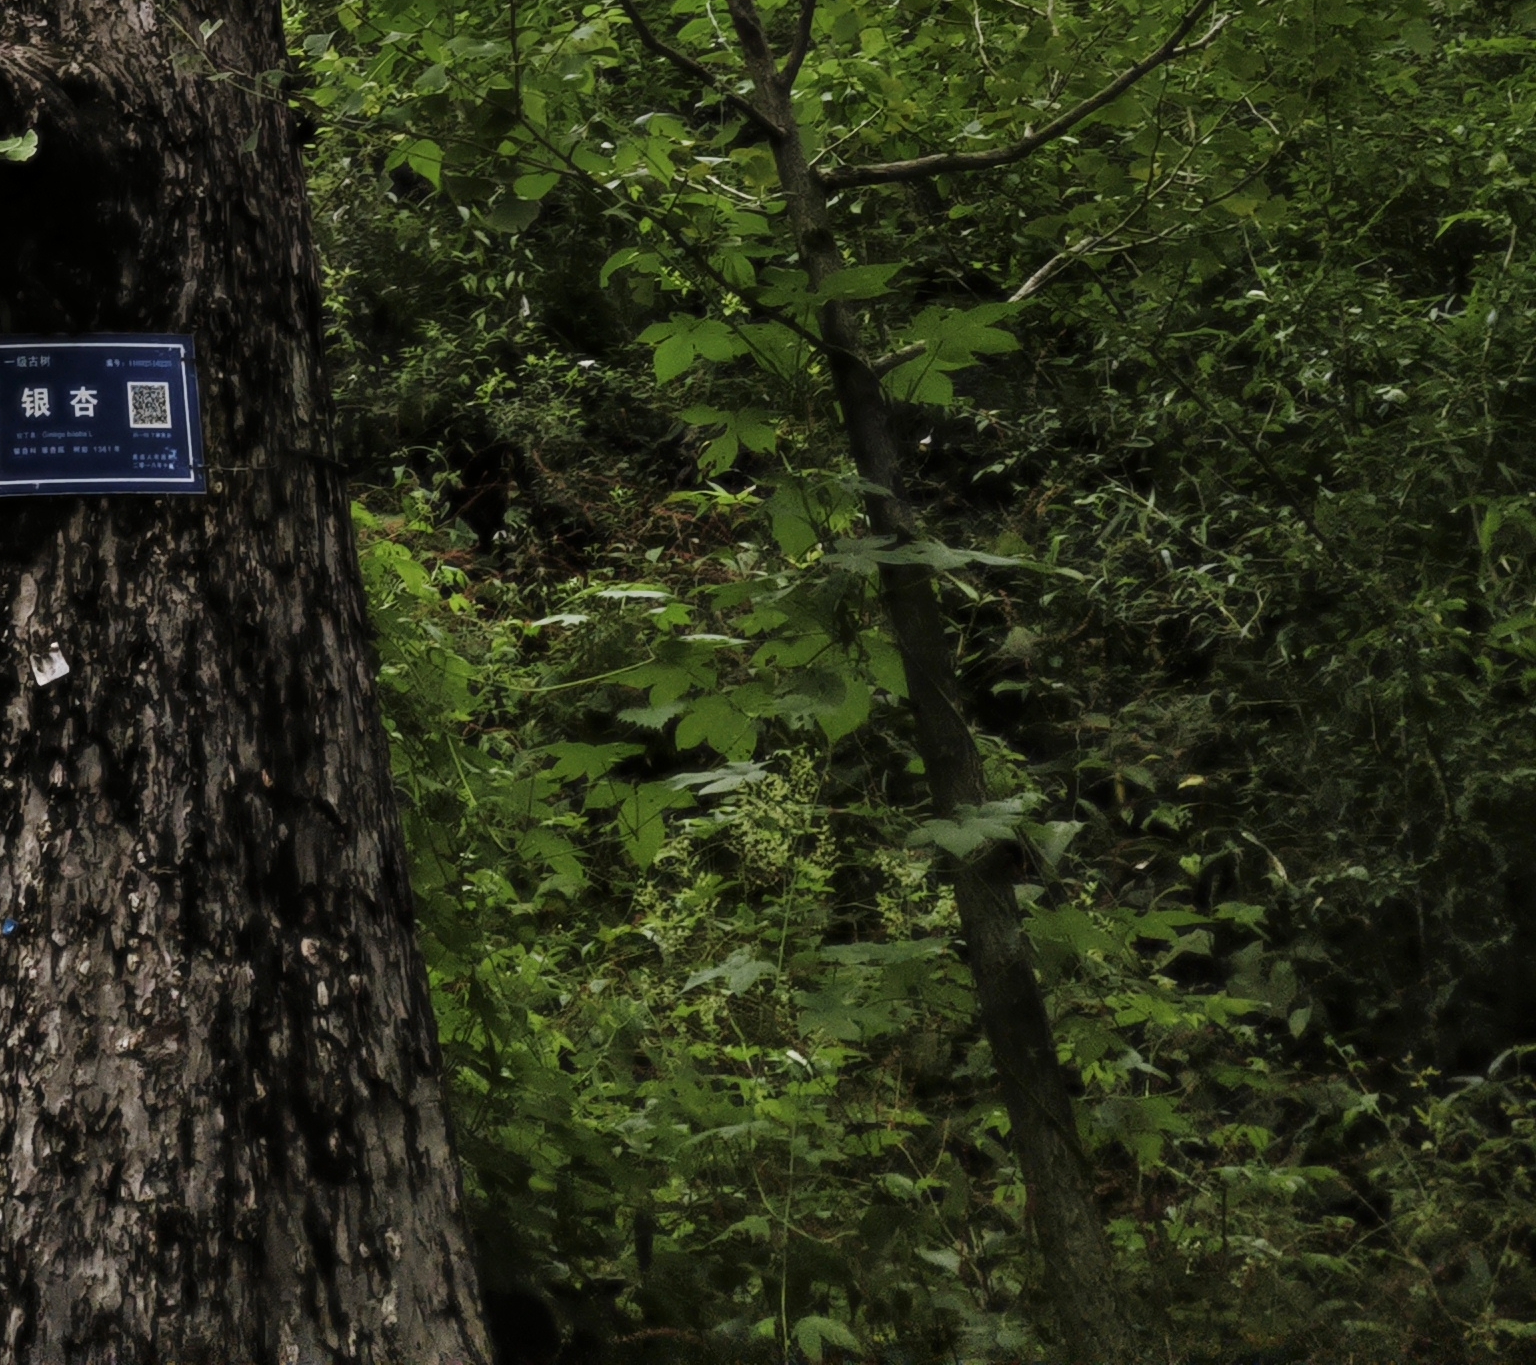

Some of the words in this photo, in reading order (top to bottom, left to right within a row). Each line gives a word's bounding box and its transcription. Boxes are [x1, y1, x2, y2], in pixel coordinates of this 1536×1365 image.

[4, 356, 51, 368] 一级古树
[21, 386, 98, 418] 银杏
